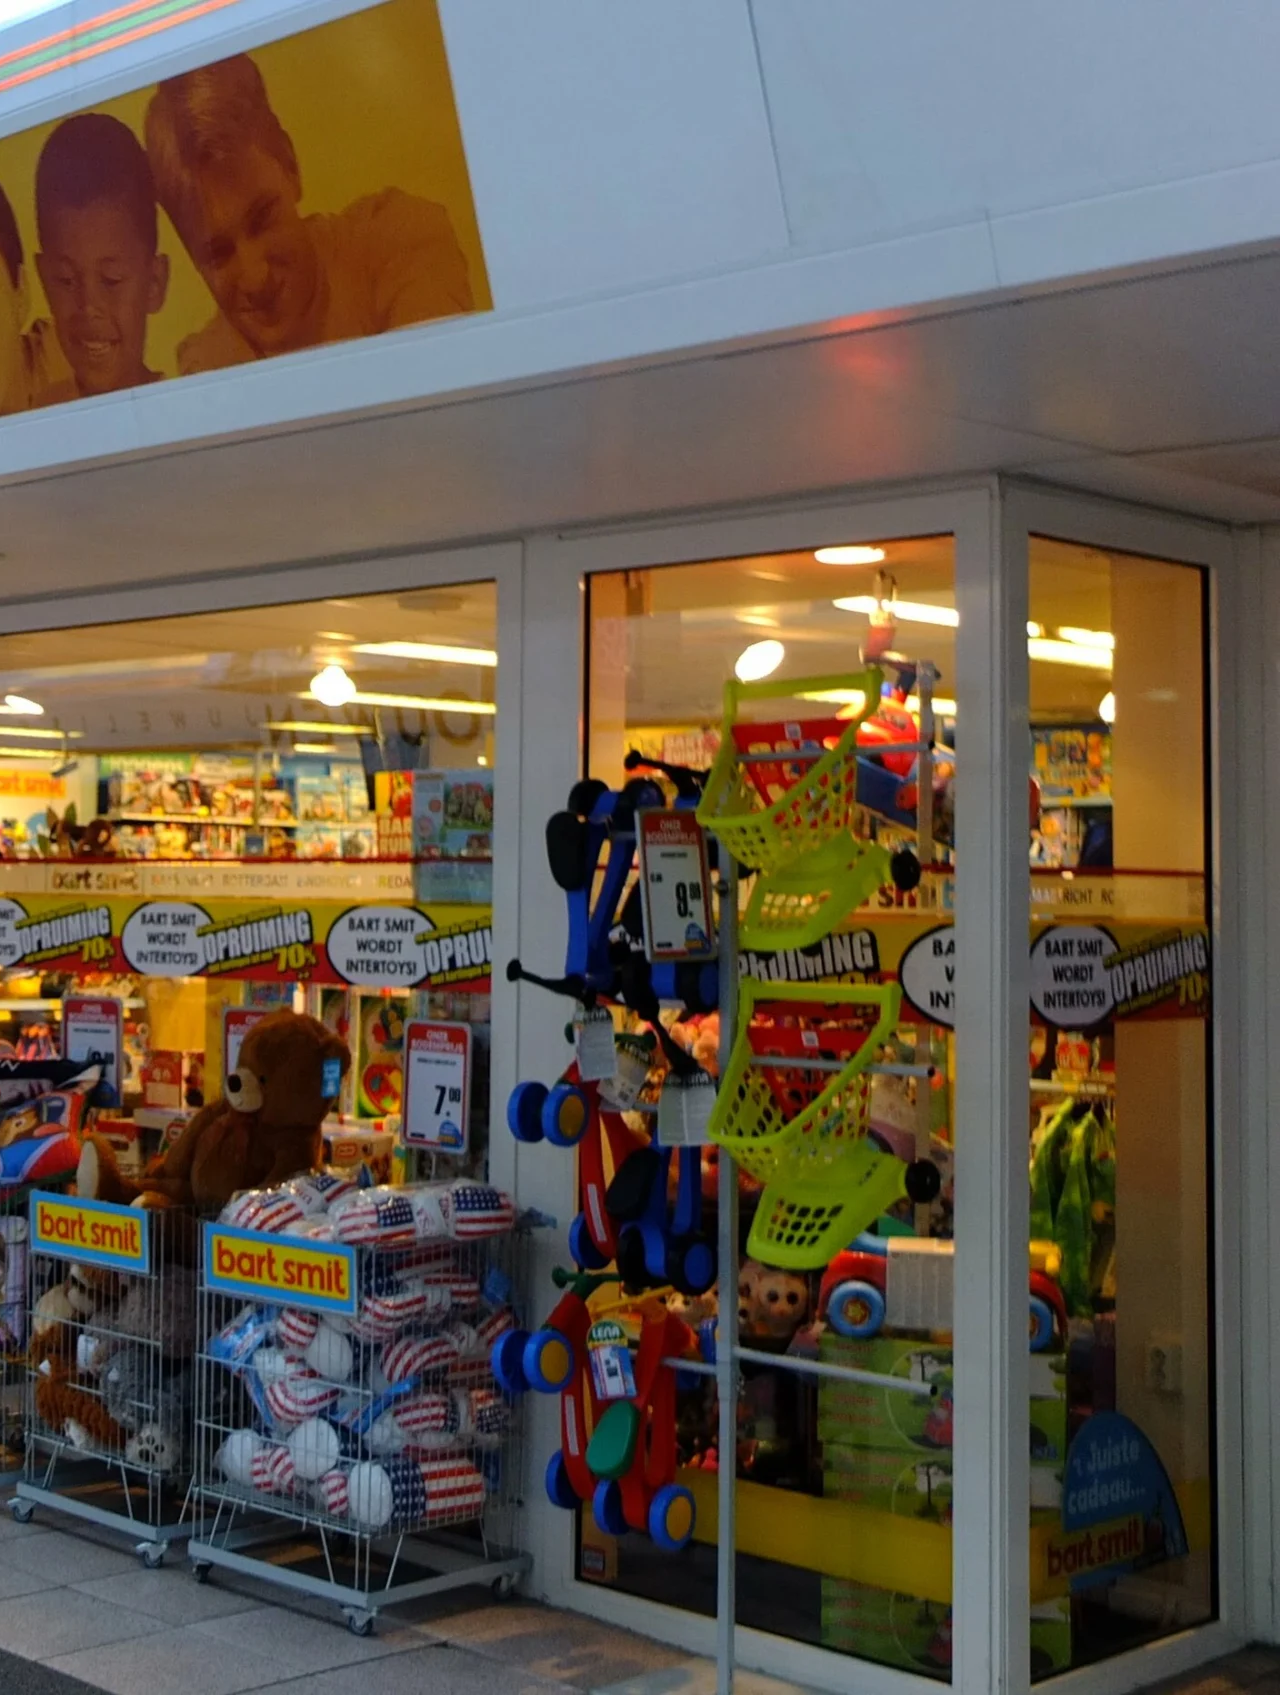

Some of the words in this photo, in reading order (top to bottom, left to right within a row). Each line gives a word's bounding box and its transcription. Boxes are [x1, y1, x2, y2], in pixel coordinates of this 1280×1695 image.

[140, 912, 169, 926] BART
[171, 913, 197, 926] SMIT
[348, 917, 382, 932] BART
[384, 918, 417, 934] SMIT
[20, 906, 111, 954] OPRUIMING
[147, 932, 187, 946] WORDT
[203, 910, 312, 964] OPRUIMING
[356, 938, 404, 955] WORDT
[738, 930, 874, 983] PRUIMING
[932, 938, 955, 957] BA
[1044, 939, 1073, 958] BART
[1076, 940, 1103, 958] SMIT
[346, 958, 418, 977] INTERTOYS!
[1052, 964, 1094, 983] WORDT
[1110, 931, 1208, 1002] OPRUIMING
[1043, 989, 1106, 1009] INTERTOYS!
[40, 1205, 87, 1243] bart
[90, 1215, 140, 1255] smit
[217, 1240, 278, 1283] bart
[283, 1253, 347, 1296] smit
[590, 1321, 621, 1341] LENA
[1087, 1436, 1141, 1475] Juiste
[1047, 1532, 1095, 1578] bart
[1096, 1518, 1143, 1566] smit
